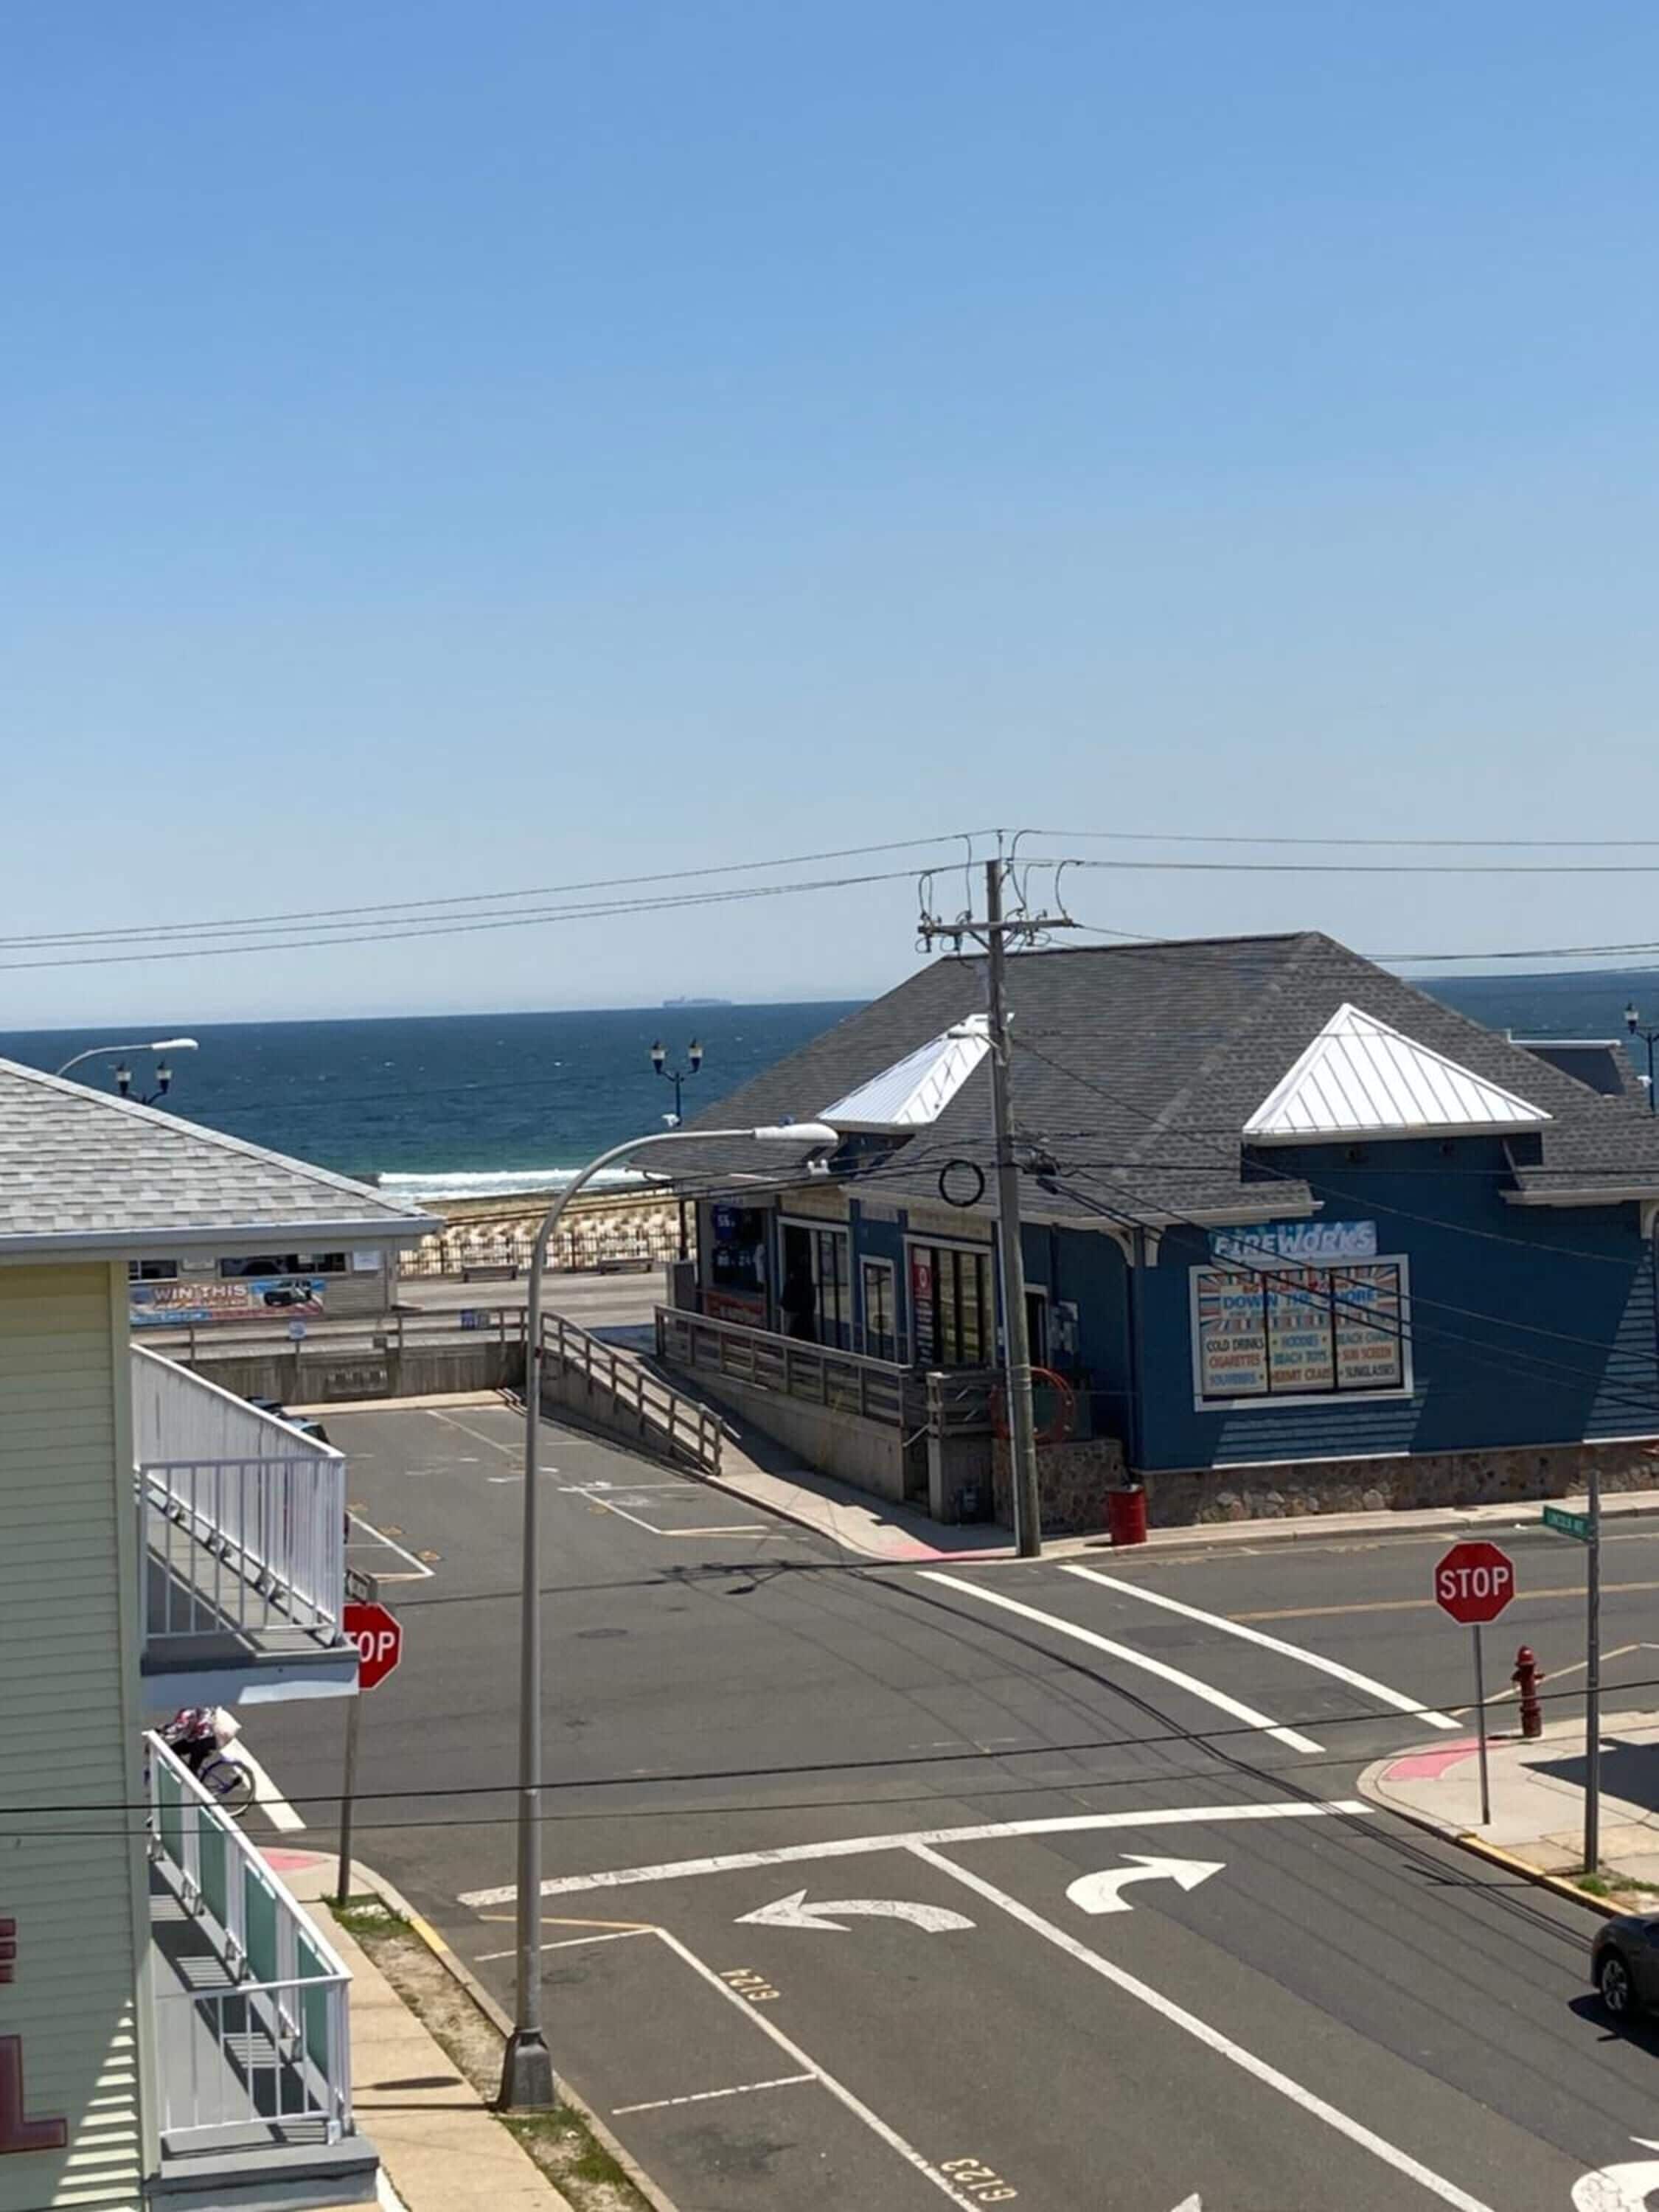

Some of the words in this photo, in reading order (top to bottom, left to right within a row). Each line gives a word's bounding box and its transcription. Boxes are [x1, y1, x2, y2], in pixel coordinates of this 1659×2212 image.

[1215, 1225, 1373, 1254] FIREWORKS
[154, 1287, 193, 1300] WIN
[201, 1284, 248, 1298] THIS
[1223, 1293, 1278, 1309] DOWN
[1206, 1338, 1230, 1352] COLD
[1233, 1337, 1264, 1350] DRINKS
[1208, 1354, 1261, 1368] CIGARETTES
[1345, 1363, 1396, 1379] SUNGLASSES
[1439, 1566, 1509, 1601] STOP
[350, 1630, 396, 1663] OP
